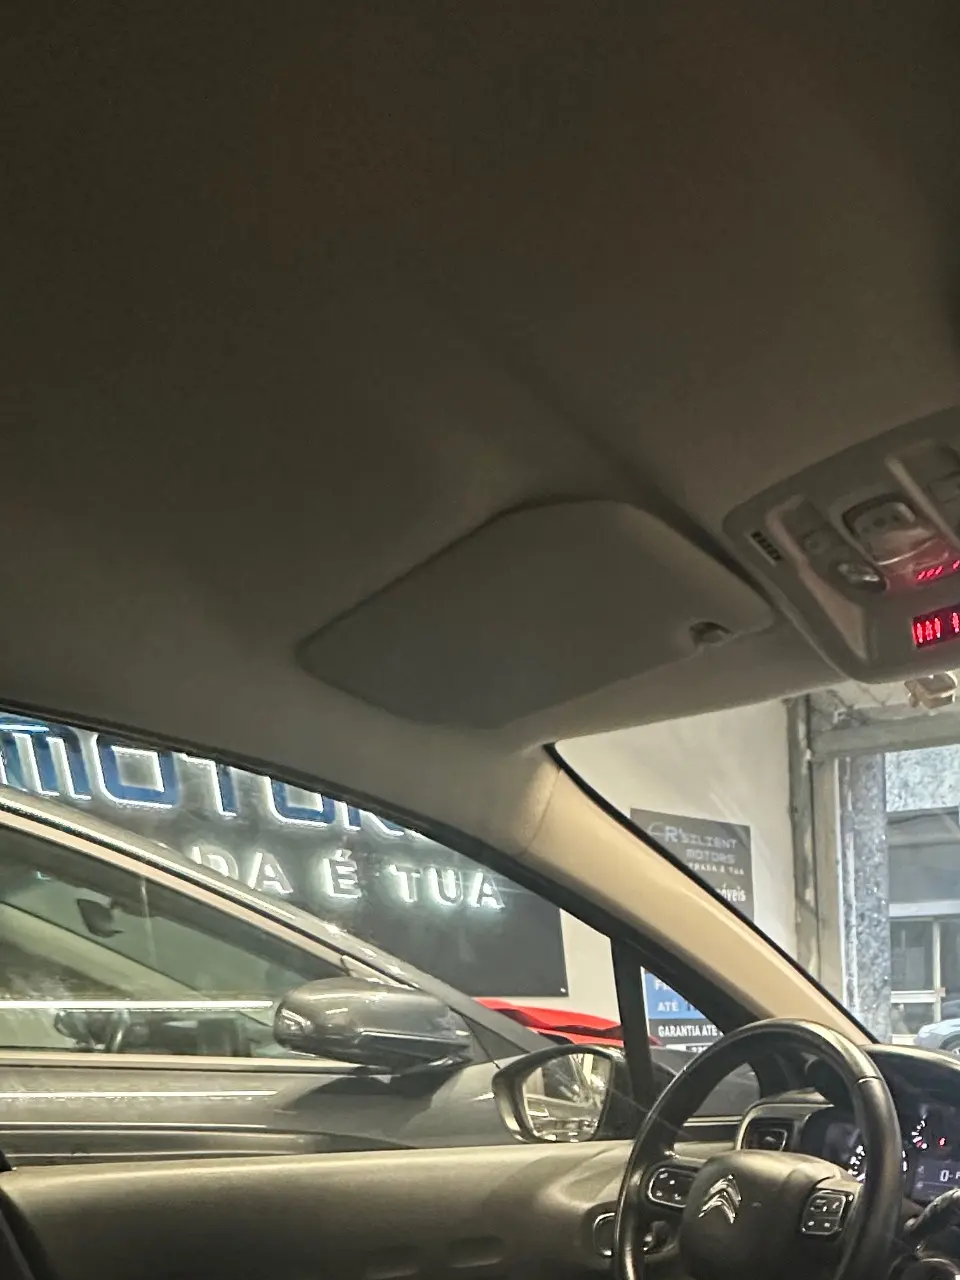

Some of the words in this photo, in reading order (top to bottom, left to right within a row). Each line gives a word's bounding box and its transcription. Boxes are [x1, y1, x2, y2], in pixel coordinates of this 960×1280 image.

[685, 848, 736, 864] MOTORS
[323, 849, 361, 898] É
[388, 862, 505, 908] TUA
[658, 1024, 701, 1037] GARANTIA
